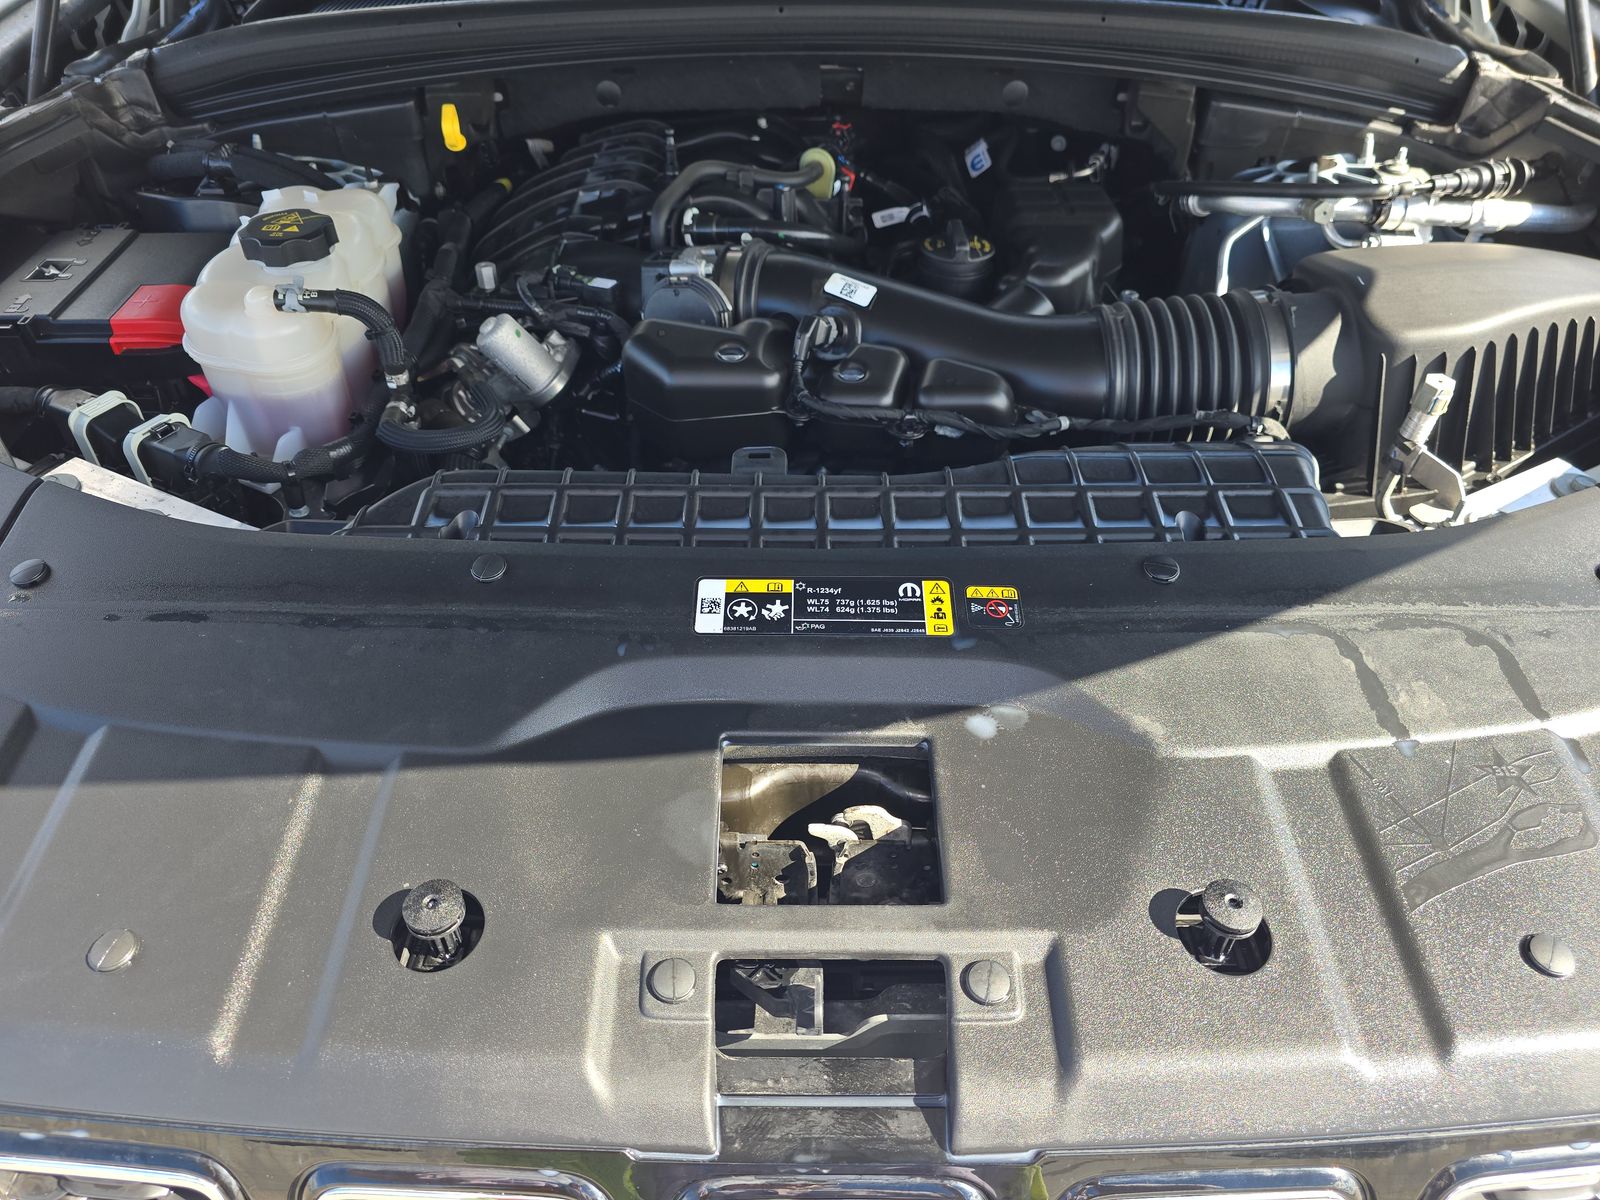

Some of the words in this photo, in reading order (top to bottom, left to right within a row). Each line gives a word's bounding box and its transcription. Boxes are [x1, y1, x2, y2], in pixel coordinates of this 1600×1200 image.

[835, 599, 855, 607] 737g
[882, 599, 898, 607] lbs)
[835, 606, 855, 614] 624g
[856, 606, 881, 614] (1.375
[882, 606, 898, 614] lbs)
[1492, 765, 1518, 777] 313
